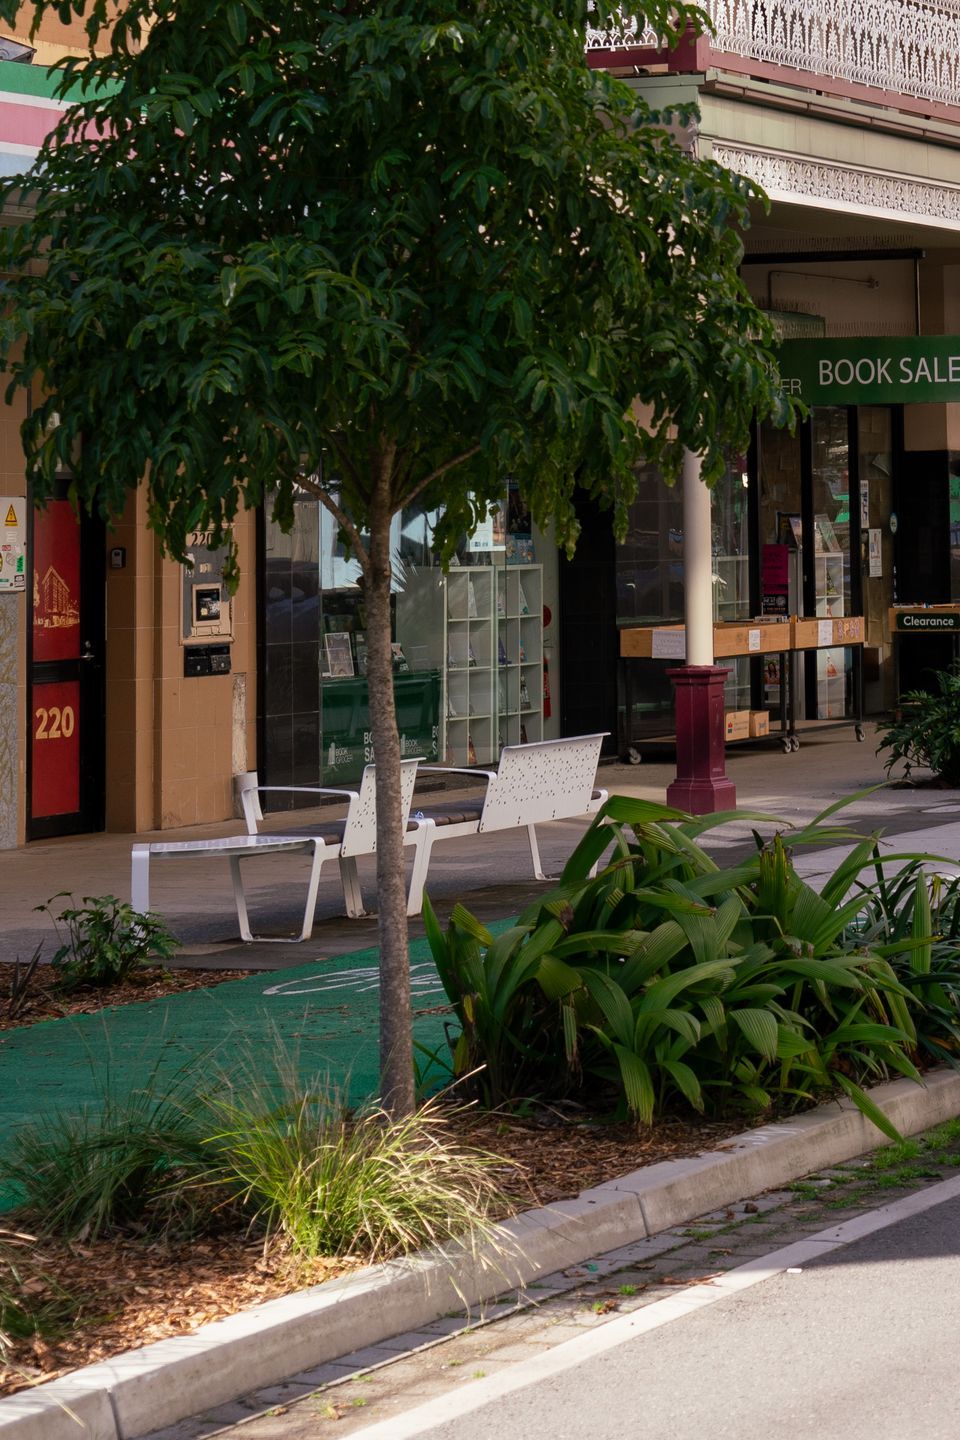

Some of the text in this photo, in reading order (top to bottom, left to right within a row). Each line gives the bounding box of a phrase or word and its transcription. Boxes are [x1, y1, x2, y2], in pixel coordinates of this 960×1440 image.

[819, 358, 892, 385] BOOK
[903, 615, 954, 626] Clearance
[35, 706, 75, 740] 220
